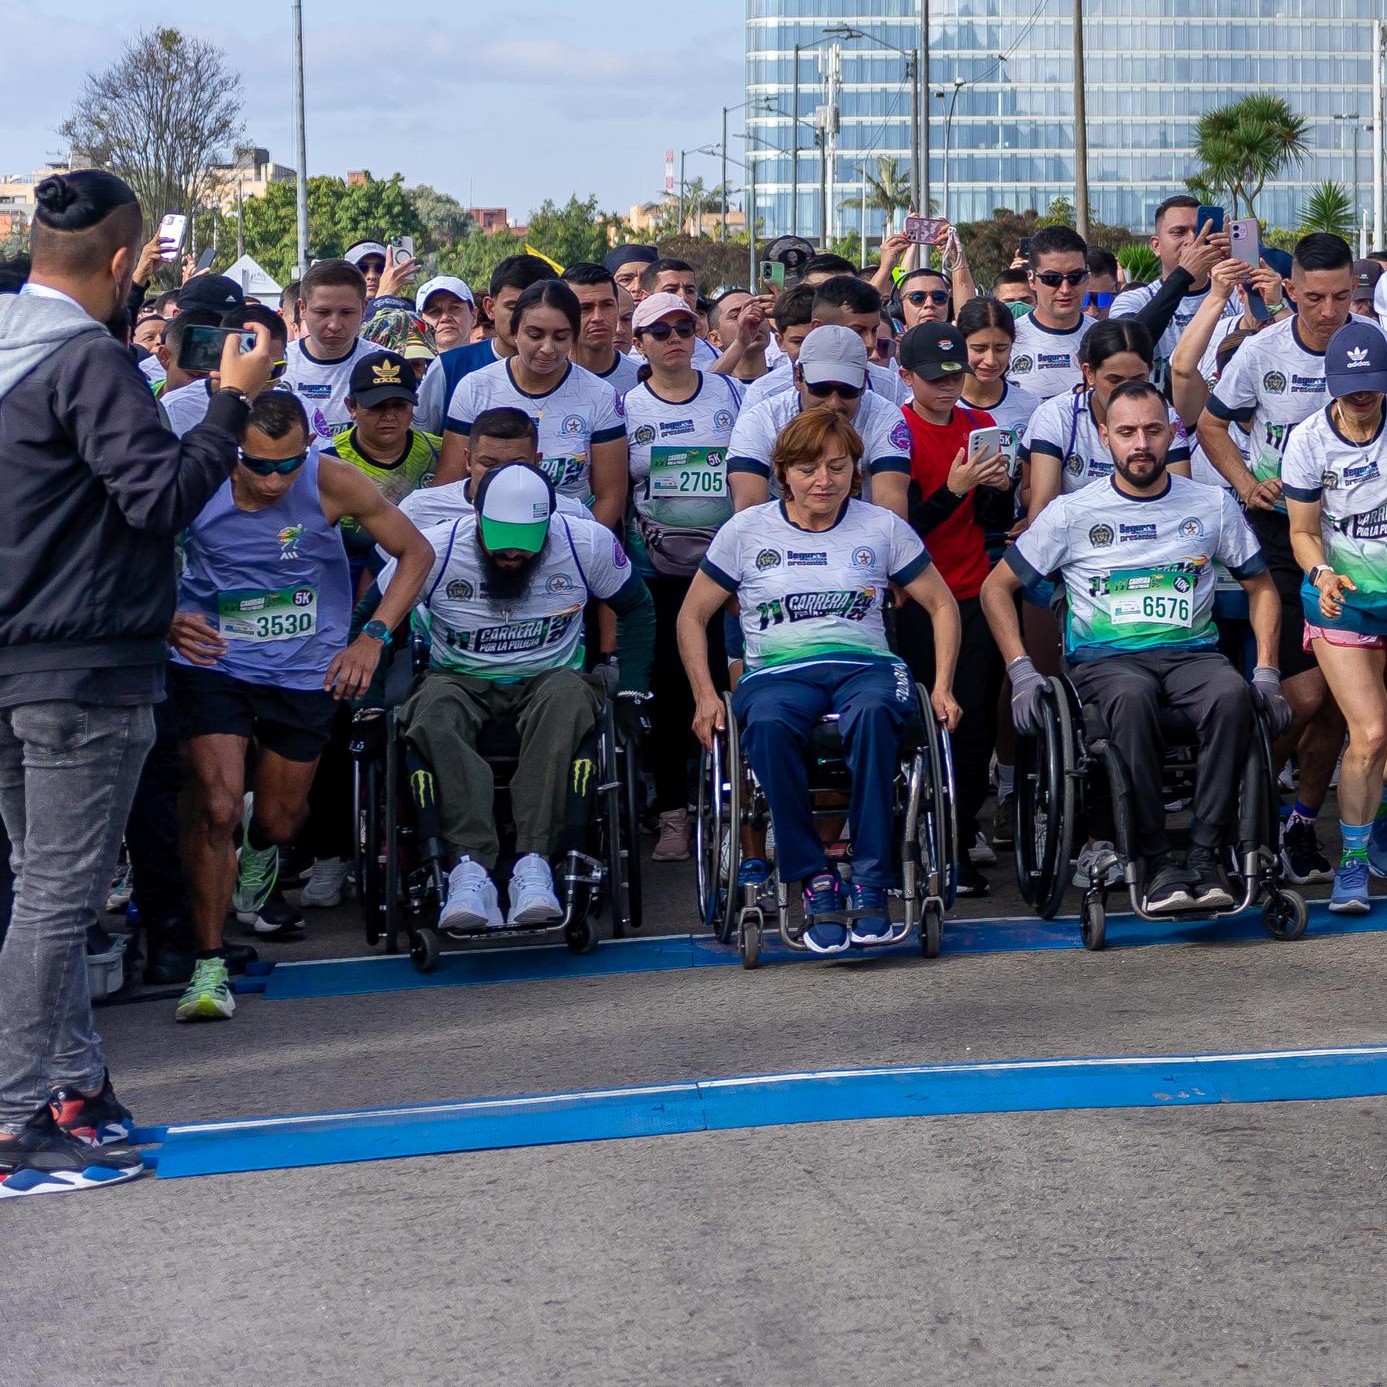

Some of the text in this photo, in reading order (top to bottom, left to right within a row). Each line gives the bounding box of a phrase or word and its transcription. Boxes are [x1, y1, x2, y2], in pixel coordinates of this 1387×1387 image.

[372, 376, 401, 384] adidas
[707, 454, 721, 465] 5K
[680, 471, 723, 491] 2705
[1175, 576, 1190, 592] 10K
[295, 591, 311, 604] 5K
[789, 593, 852, 612] CARRERA
[1143, 596, 1189, 621] 6576
[256, 613, 312, 637] 3530
[481, 620, 544, 642] CARRERA
[497, 641, 507, 651] LA
